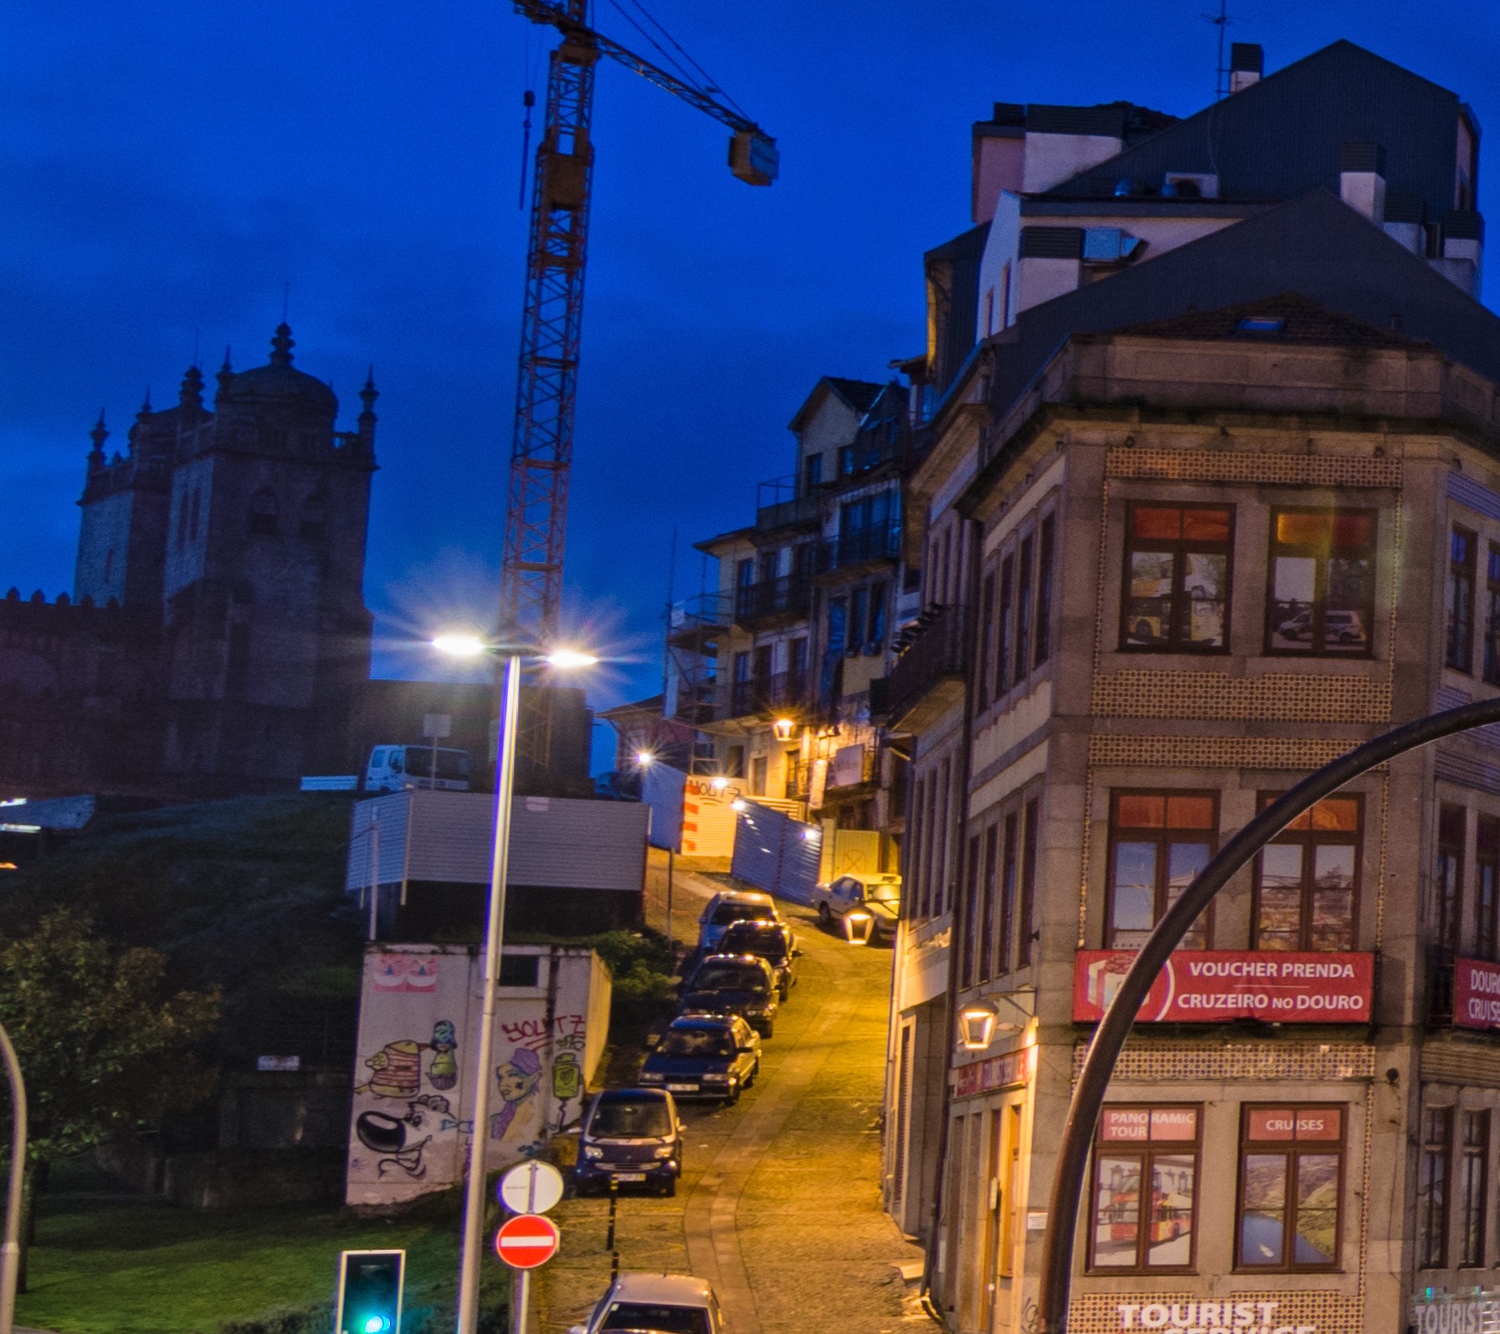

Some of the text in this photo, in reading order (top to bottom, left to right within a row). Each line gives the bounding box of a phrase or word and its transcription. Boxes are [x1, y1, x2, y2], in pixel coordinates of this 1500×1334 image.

[1189, 961, 1354, 978] VOUCHER PRENDA
[1177, 993, 1363, 1010] CRUZEIRO NO DOURO
[1110, 1113, 1195, 1125] PANORAMIC
[1265, 1119, 1324, 1131] CRUISES
[1110, 1126, 1147, 1137] TOUR
[1118, 1302, 1279, 1328] TOURIST
